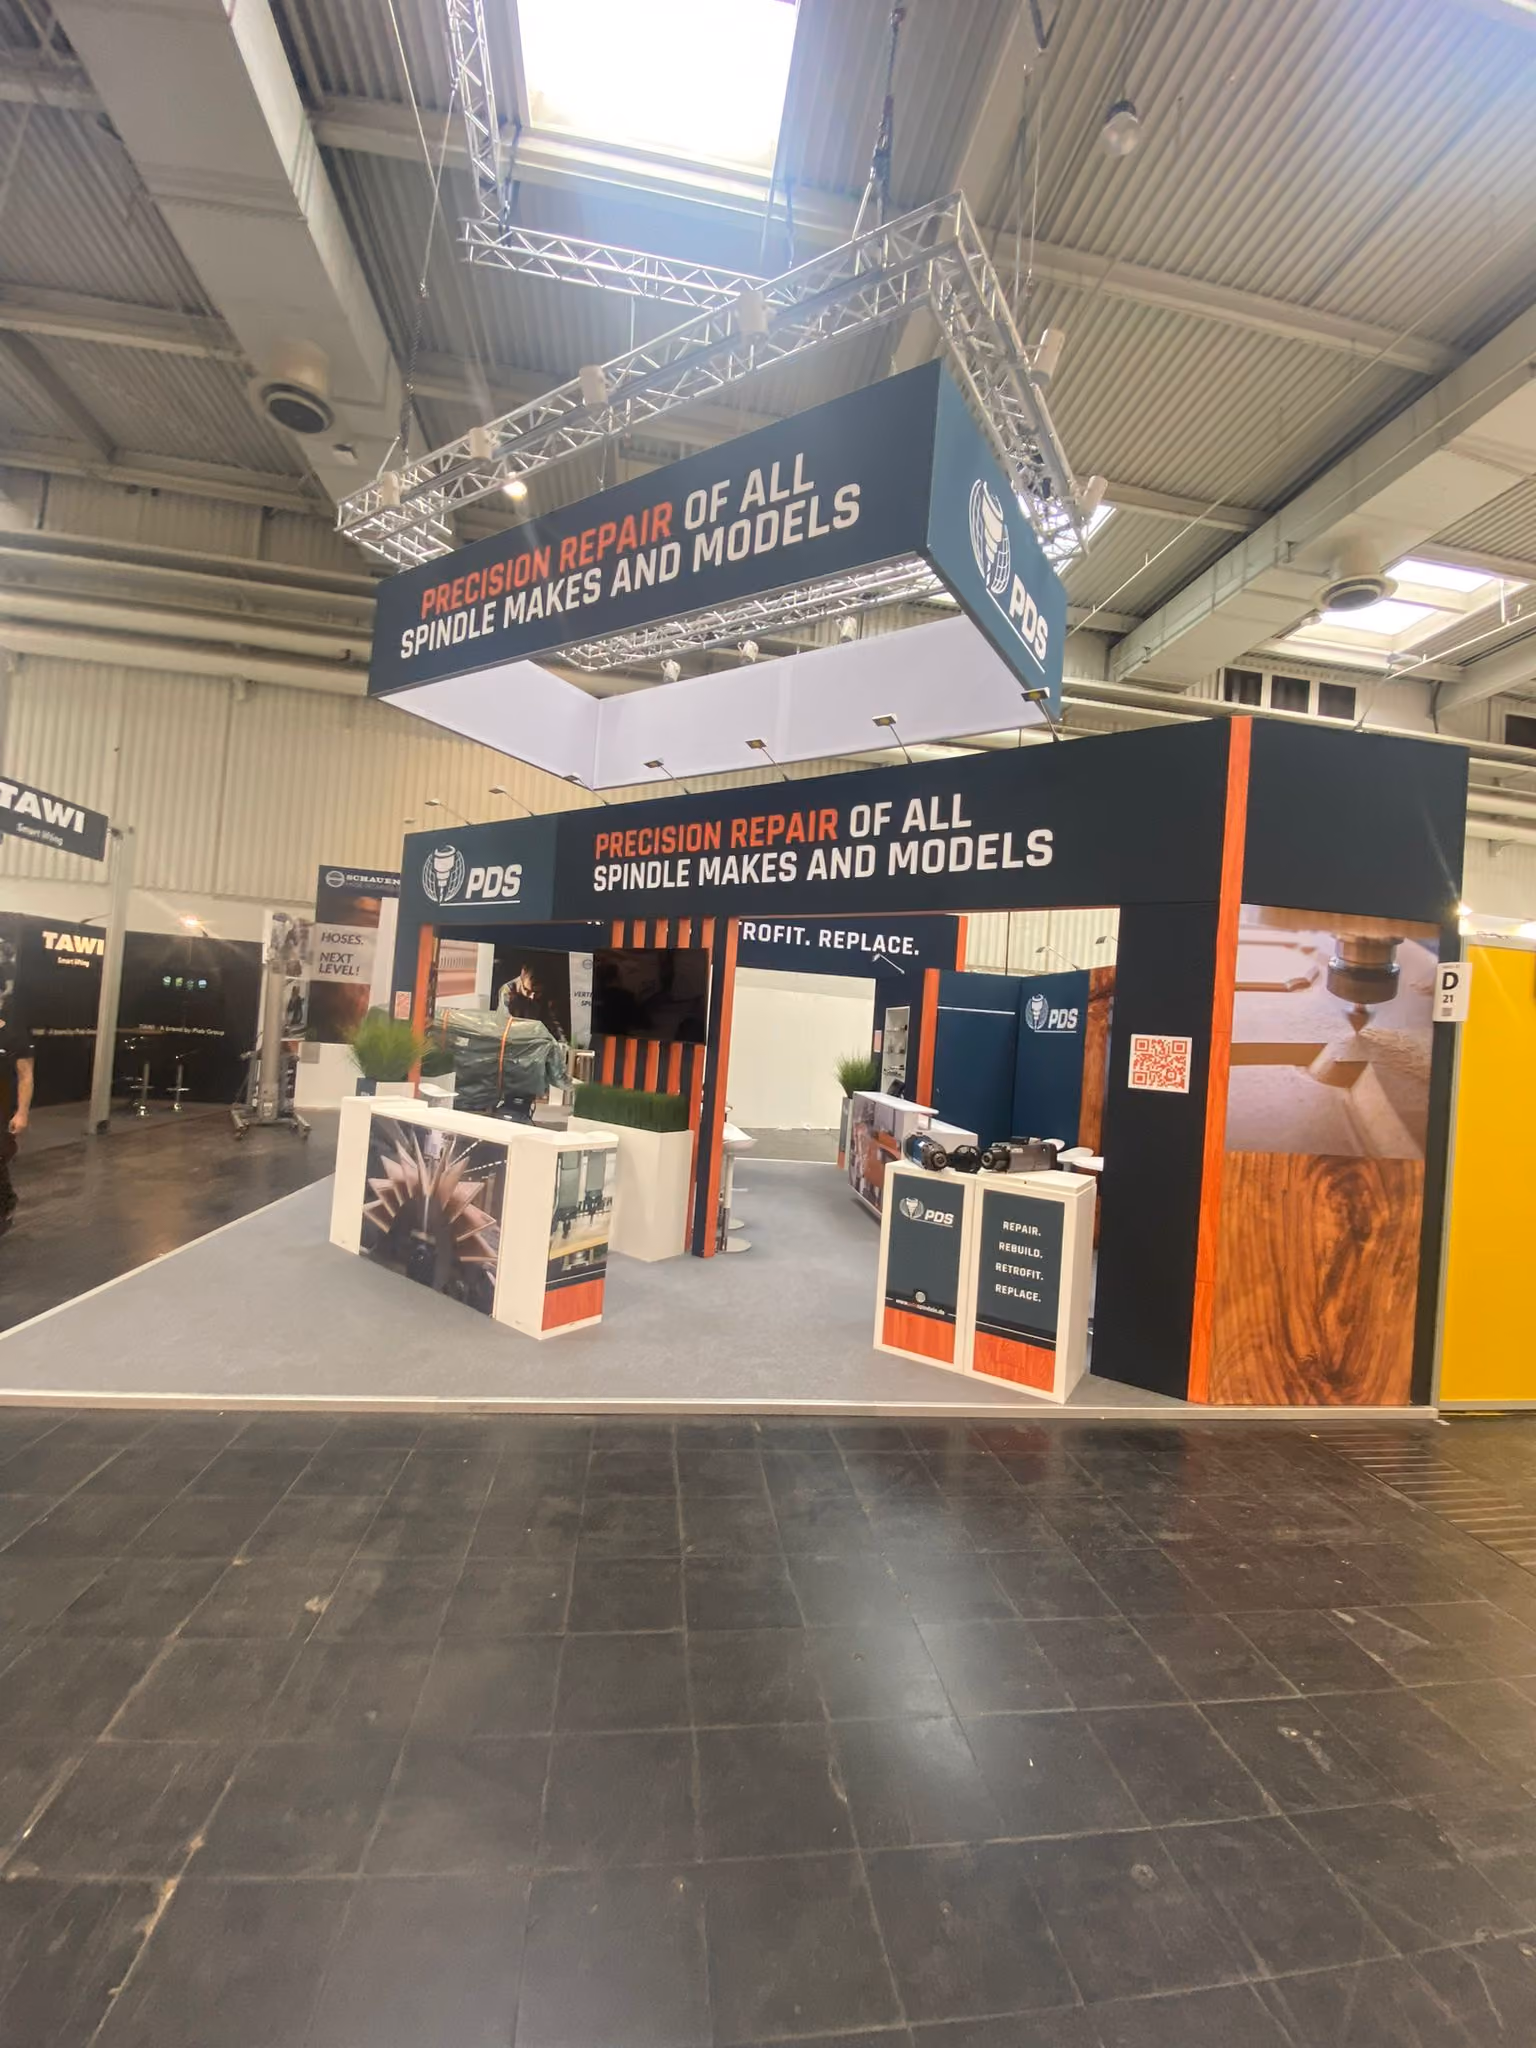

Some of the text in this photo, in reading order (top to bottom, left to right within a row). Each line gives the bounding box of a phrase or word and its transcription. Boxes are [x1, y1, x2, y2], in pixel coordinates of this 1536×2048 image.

[420, 452, 815, 620] PRECISION REPAIR OF ALL
[400, 482, 861, 660] SPINDLE MAKES AND MODELS
[1009, 573, 1048, 660] PDS
[0, 781, 86, 834] TAWI
[595, 793, 972, 860] PRECISION REPAIR OF ALL
[593, 828, 1054, 892] SPINDLE MAKES AND MODELS
[465, 864, 523, 899] PDS
[42, 931, 104, 956] TAWI
[321, 932, 364, 946] HOSES.
[738, 920, 919, 956] ROFIT. REPLACE.
[320, 952, 354, 964] NEXT
[319, 963, 360, 976] LEVEL!
[1442, 971, 1459, 990] D
[1442, 994, 1453, 1003] 21
[1048, 1008, 1079, 1029] PDS
[924, 1209, 955, 1225] PDS
[1003, 1220, 1042, 1237] REPAIR.
[999, 1241, 1043, 1259] REBUILD.
[995, 1262, 1044, 1281] RETROFIT.
[995, 1283, 1042, 1302] REPLACE.
